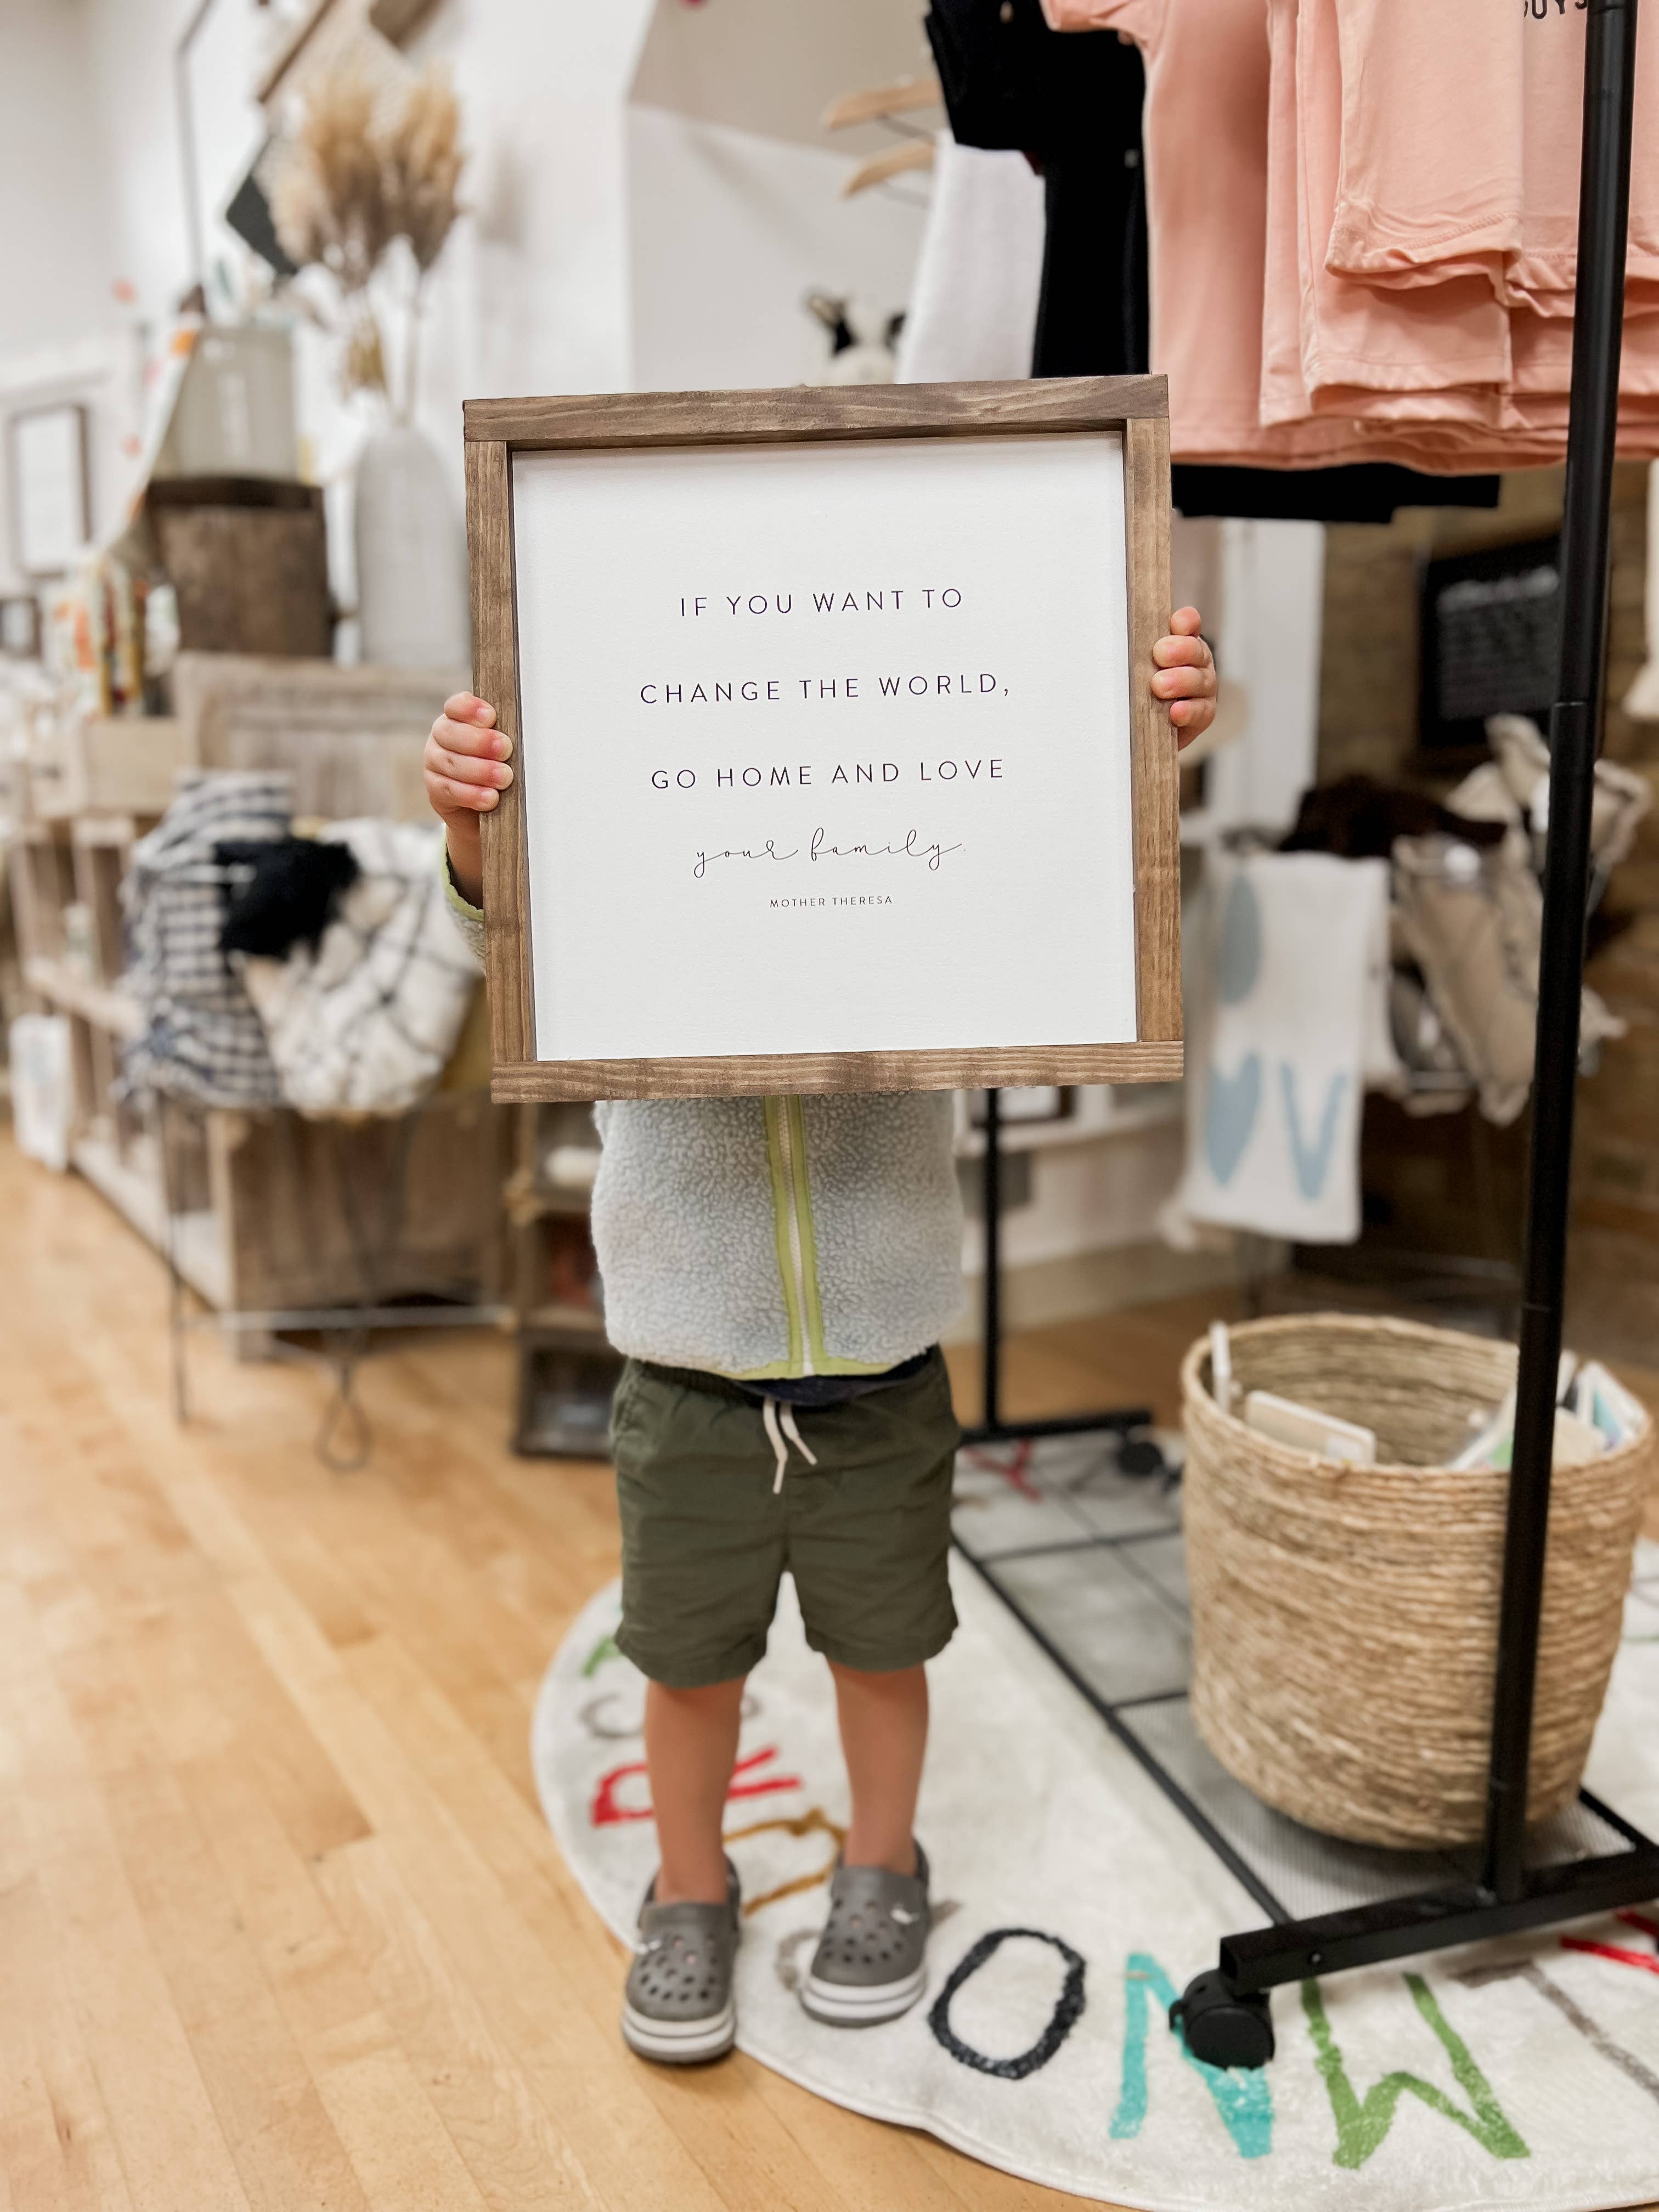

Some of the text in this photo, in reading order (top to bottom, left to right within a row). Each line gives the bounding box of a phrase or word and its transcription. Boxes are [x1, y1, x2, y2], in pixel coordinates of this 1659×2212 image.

[1523, 0, 1587, 19] UY
[681, 589, 961, 617] IF YOU WANT TO
[640, 674, 1008, 704] CHANGE THE WORLD,
[652, 759, 1002, 789] GO HOME AND LOVE
[693, 839, 799, 878] your
[770, 895, 893, 908] MOTHER THERESA
